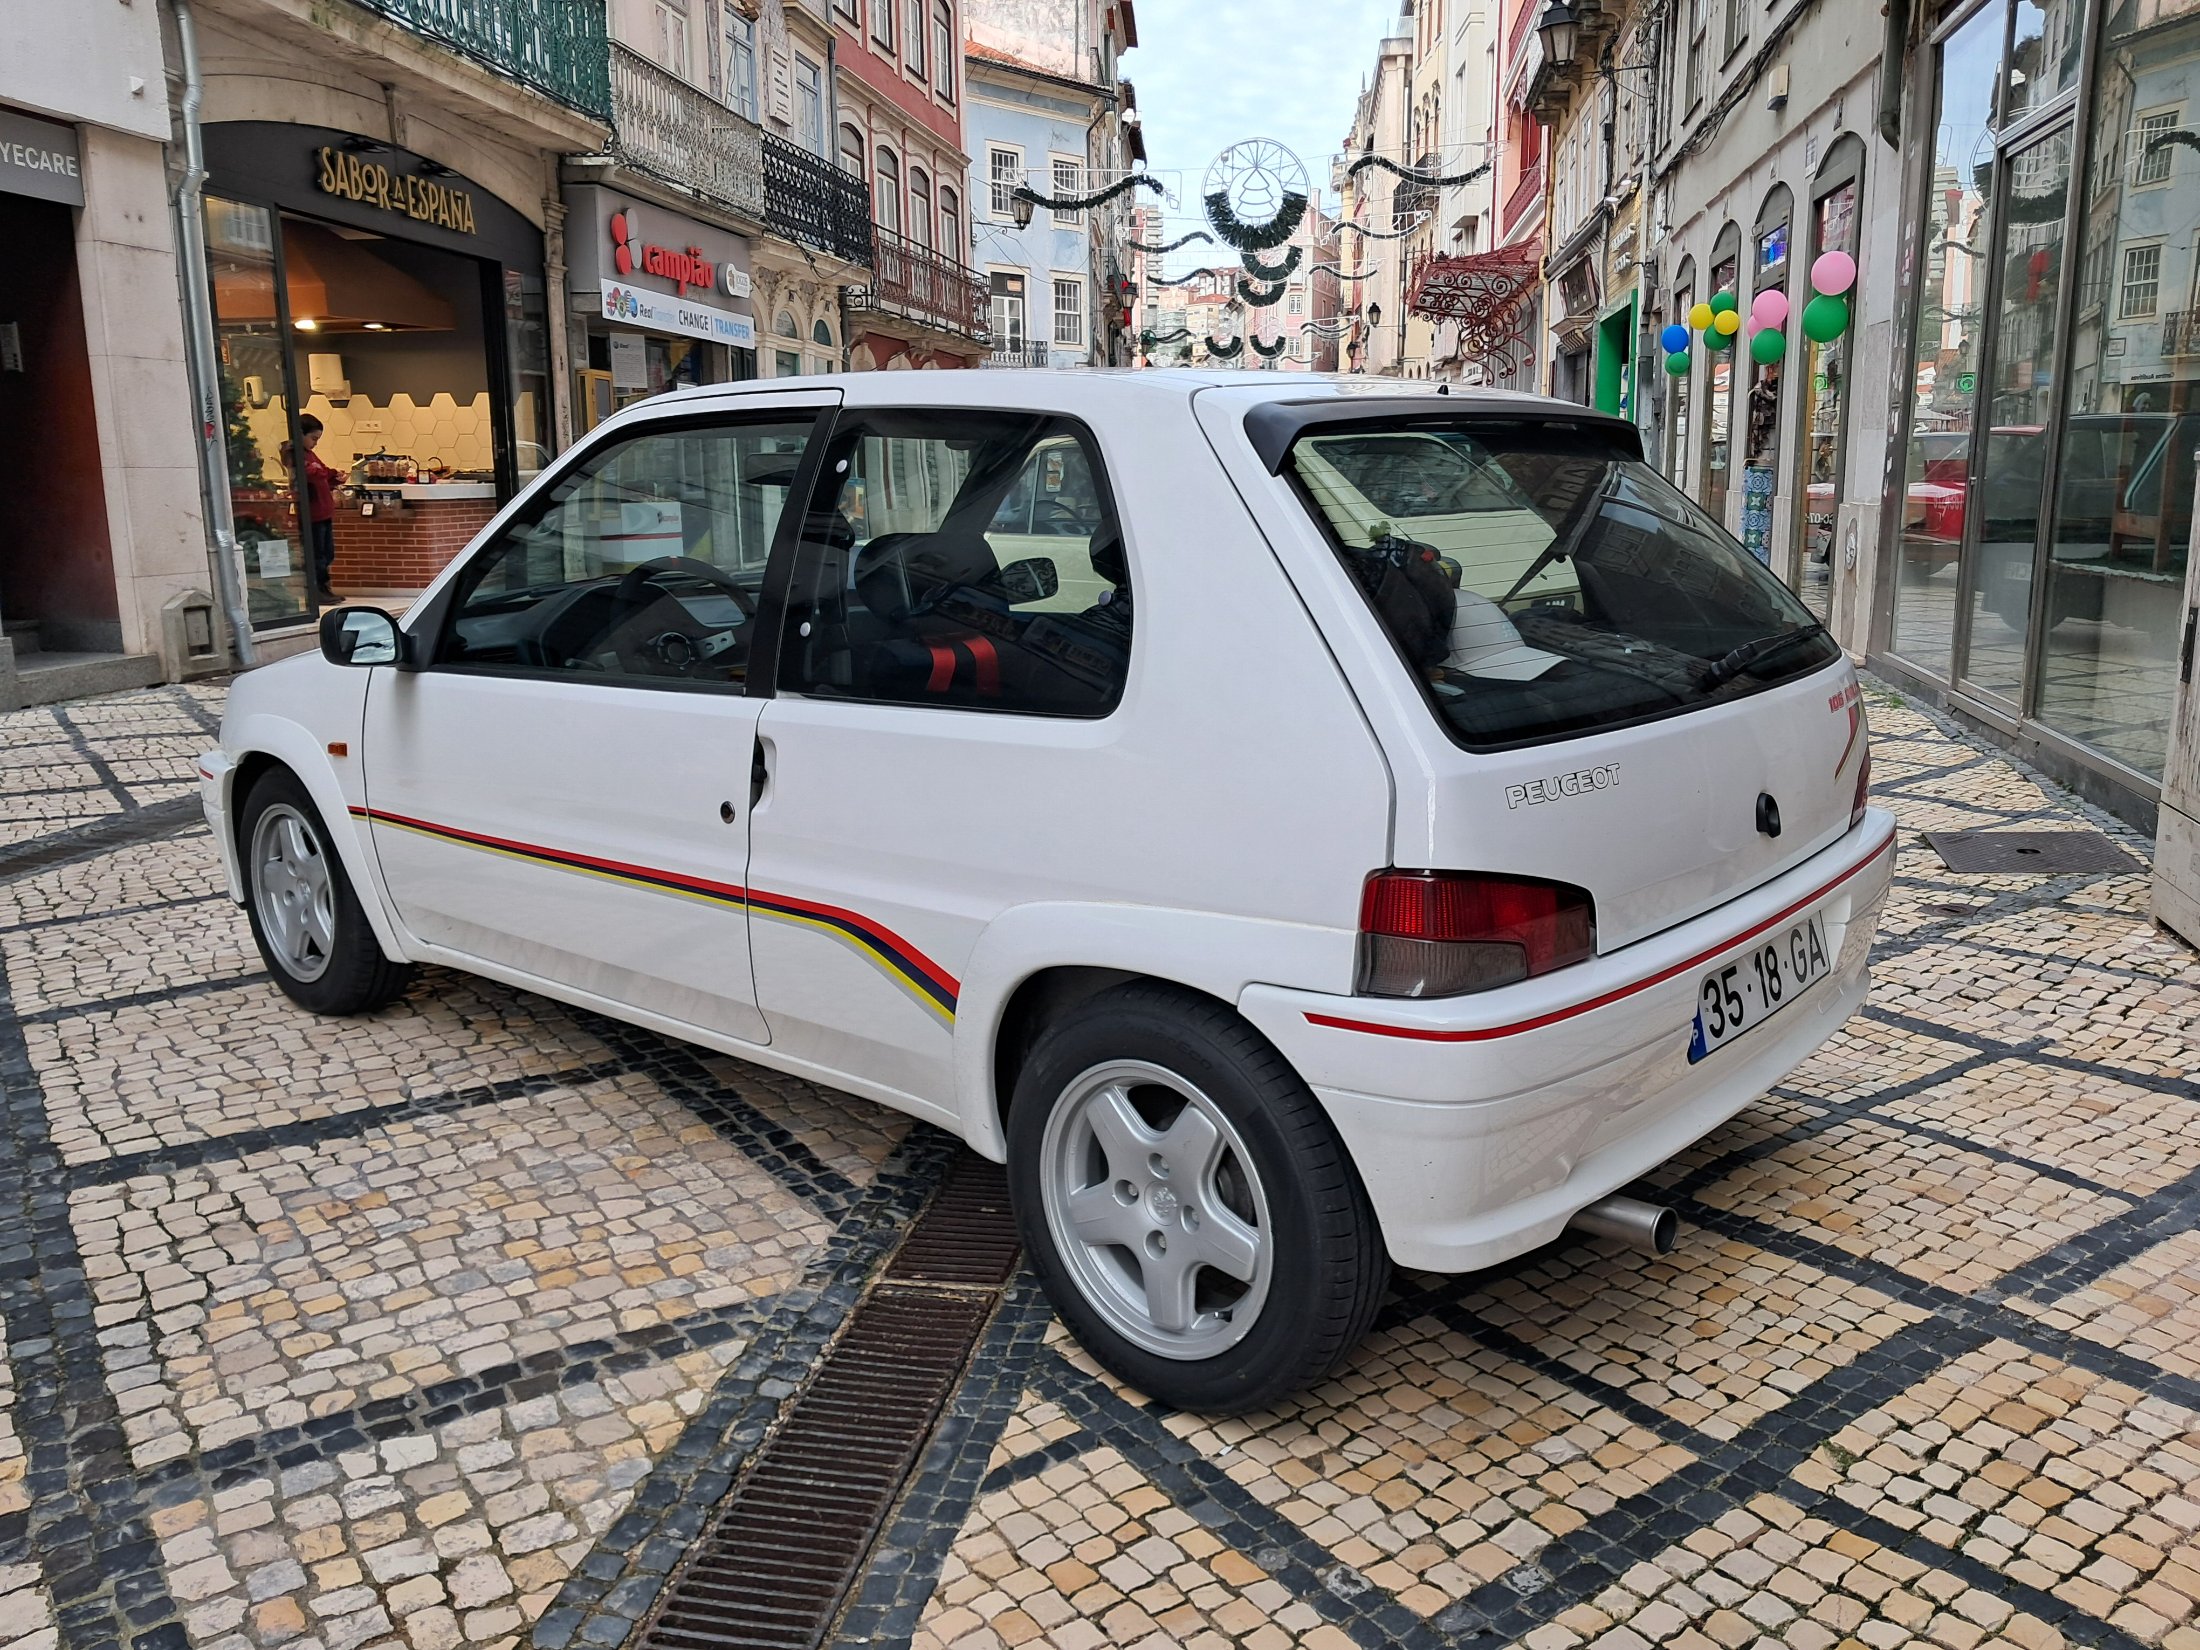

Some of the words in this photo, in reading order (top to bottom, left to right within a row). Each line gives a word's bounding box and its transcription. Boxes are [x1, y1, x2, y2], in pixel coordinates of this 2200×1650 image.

[321, 146, 392, 211] SABOR
[406, 174, 477, 235] ESPAÑA
[643, 244, 715, 297] campião
[678, 309, 709, 331] CHANGE
[714, 317, 750, 340] TRANSFER
[1504, 762, 1621, 810] PEUGEOT
